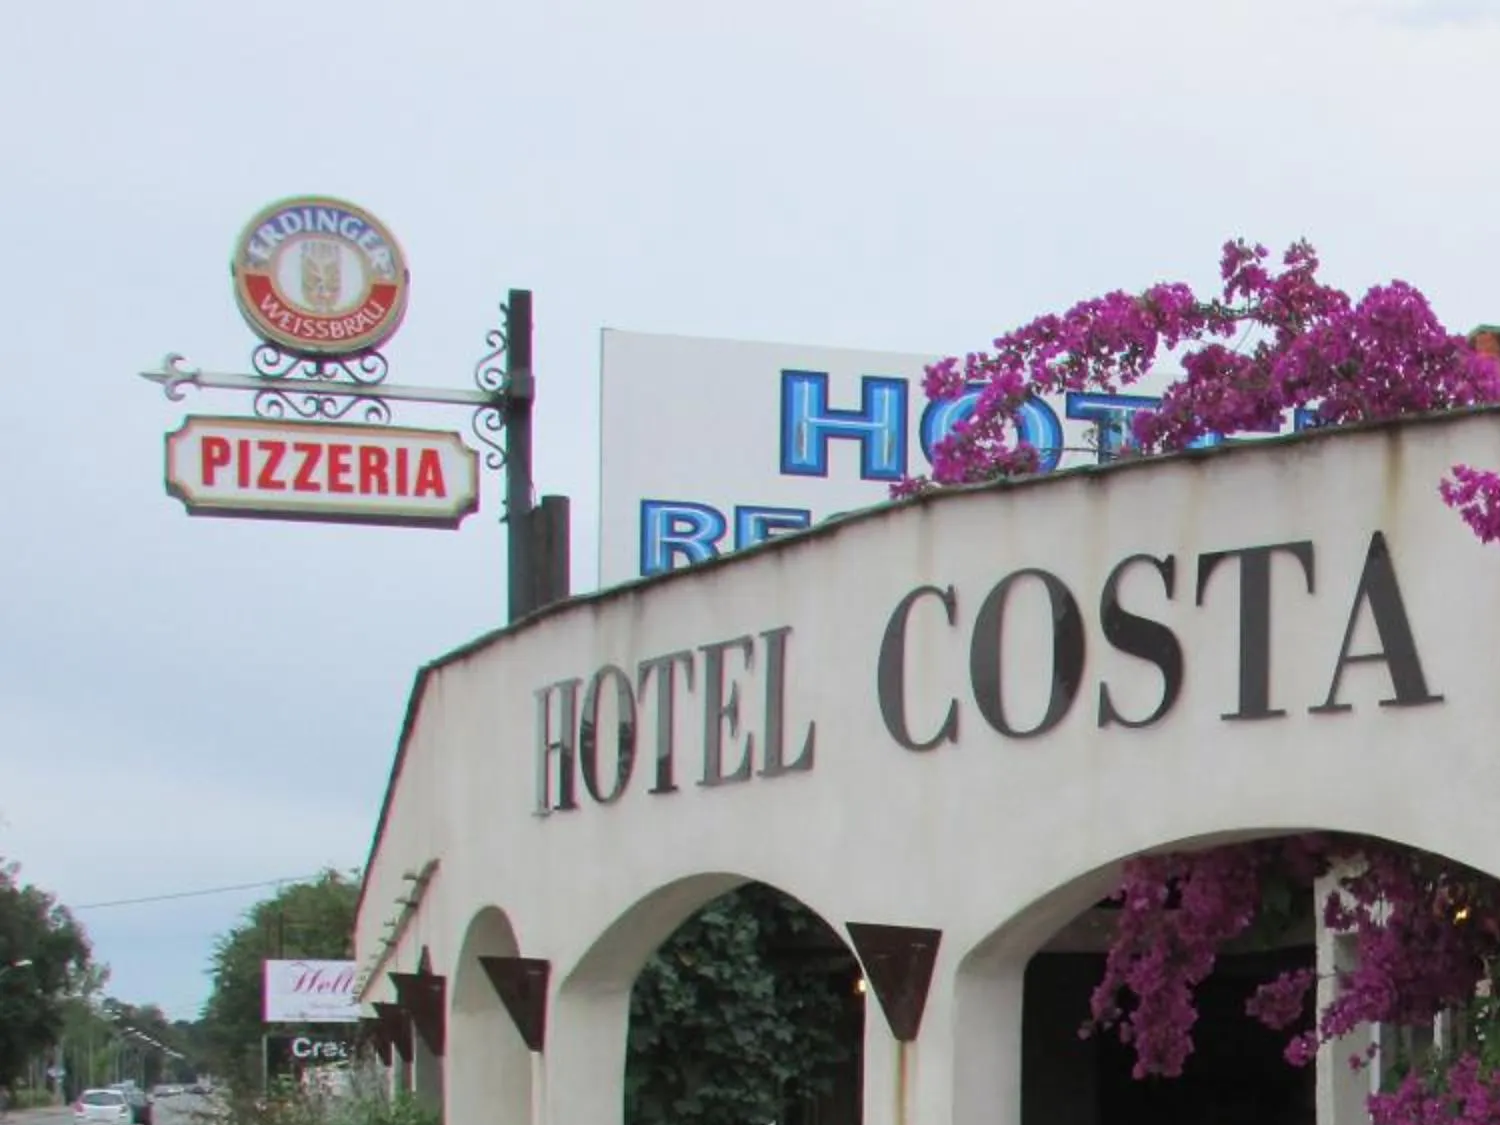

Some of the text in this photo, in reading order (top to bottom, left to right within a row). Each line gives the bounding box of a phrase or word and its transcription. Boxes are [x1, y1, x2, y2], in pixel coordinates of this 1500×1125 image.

[247, 208, 396, 279] ERDINGER
[201, 435, 447, 498] PIZZERIA
[532, 625, 816, 819] HOTEL
[877, 529, 1445, 753] COSTA
